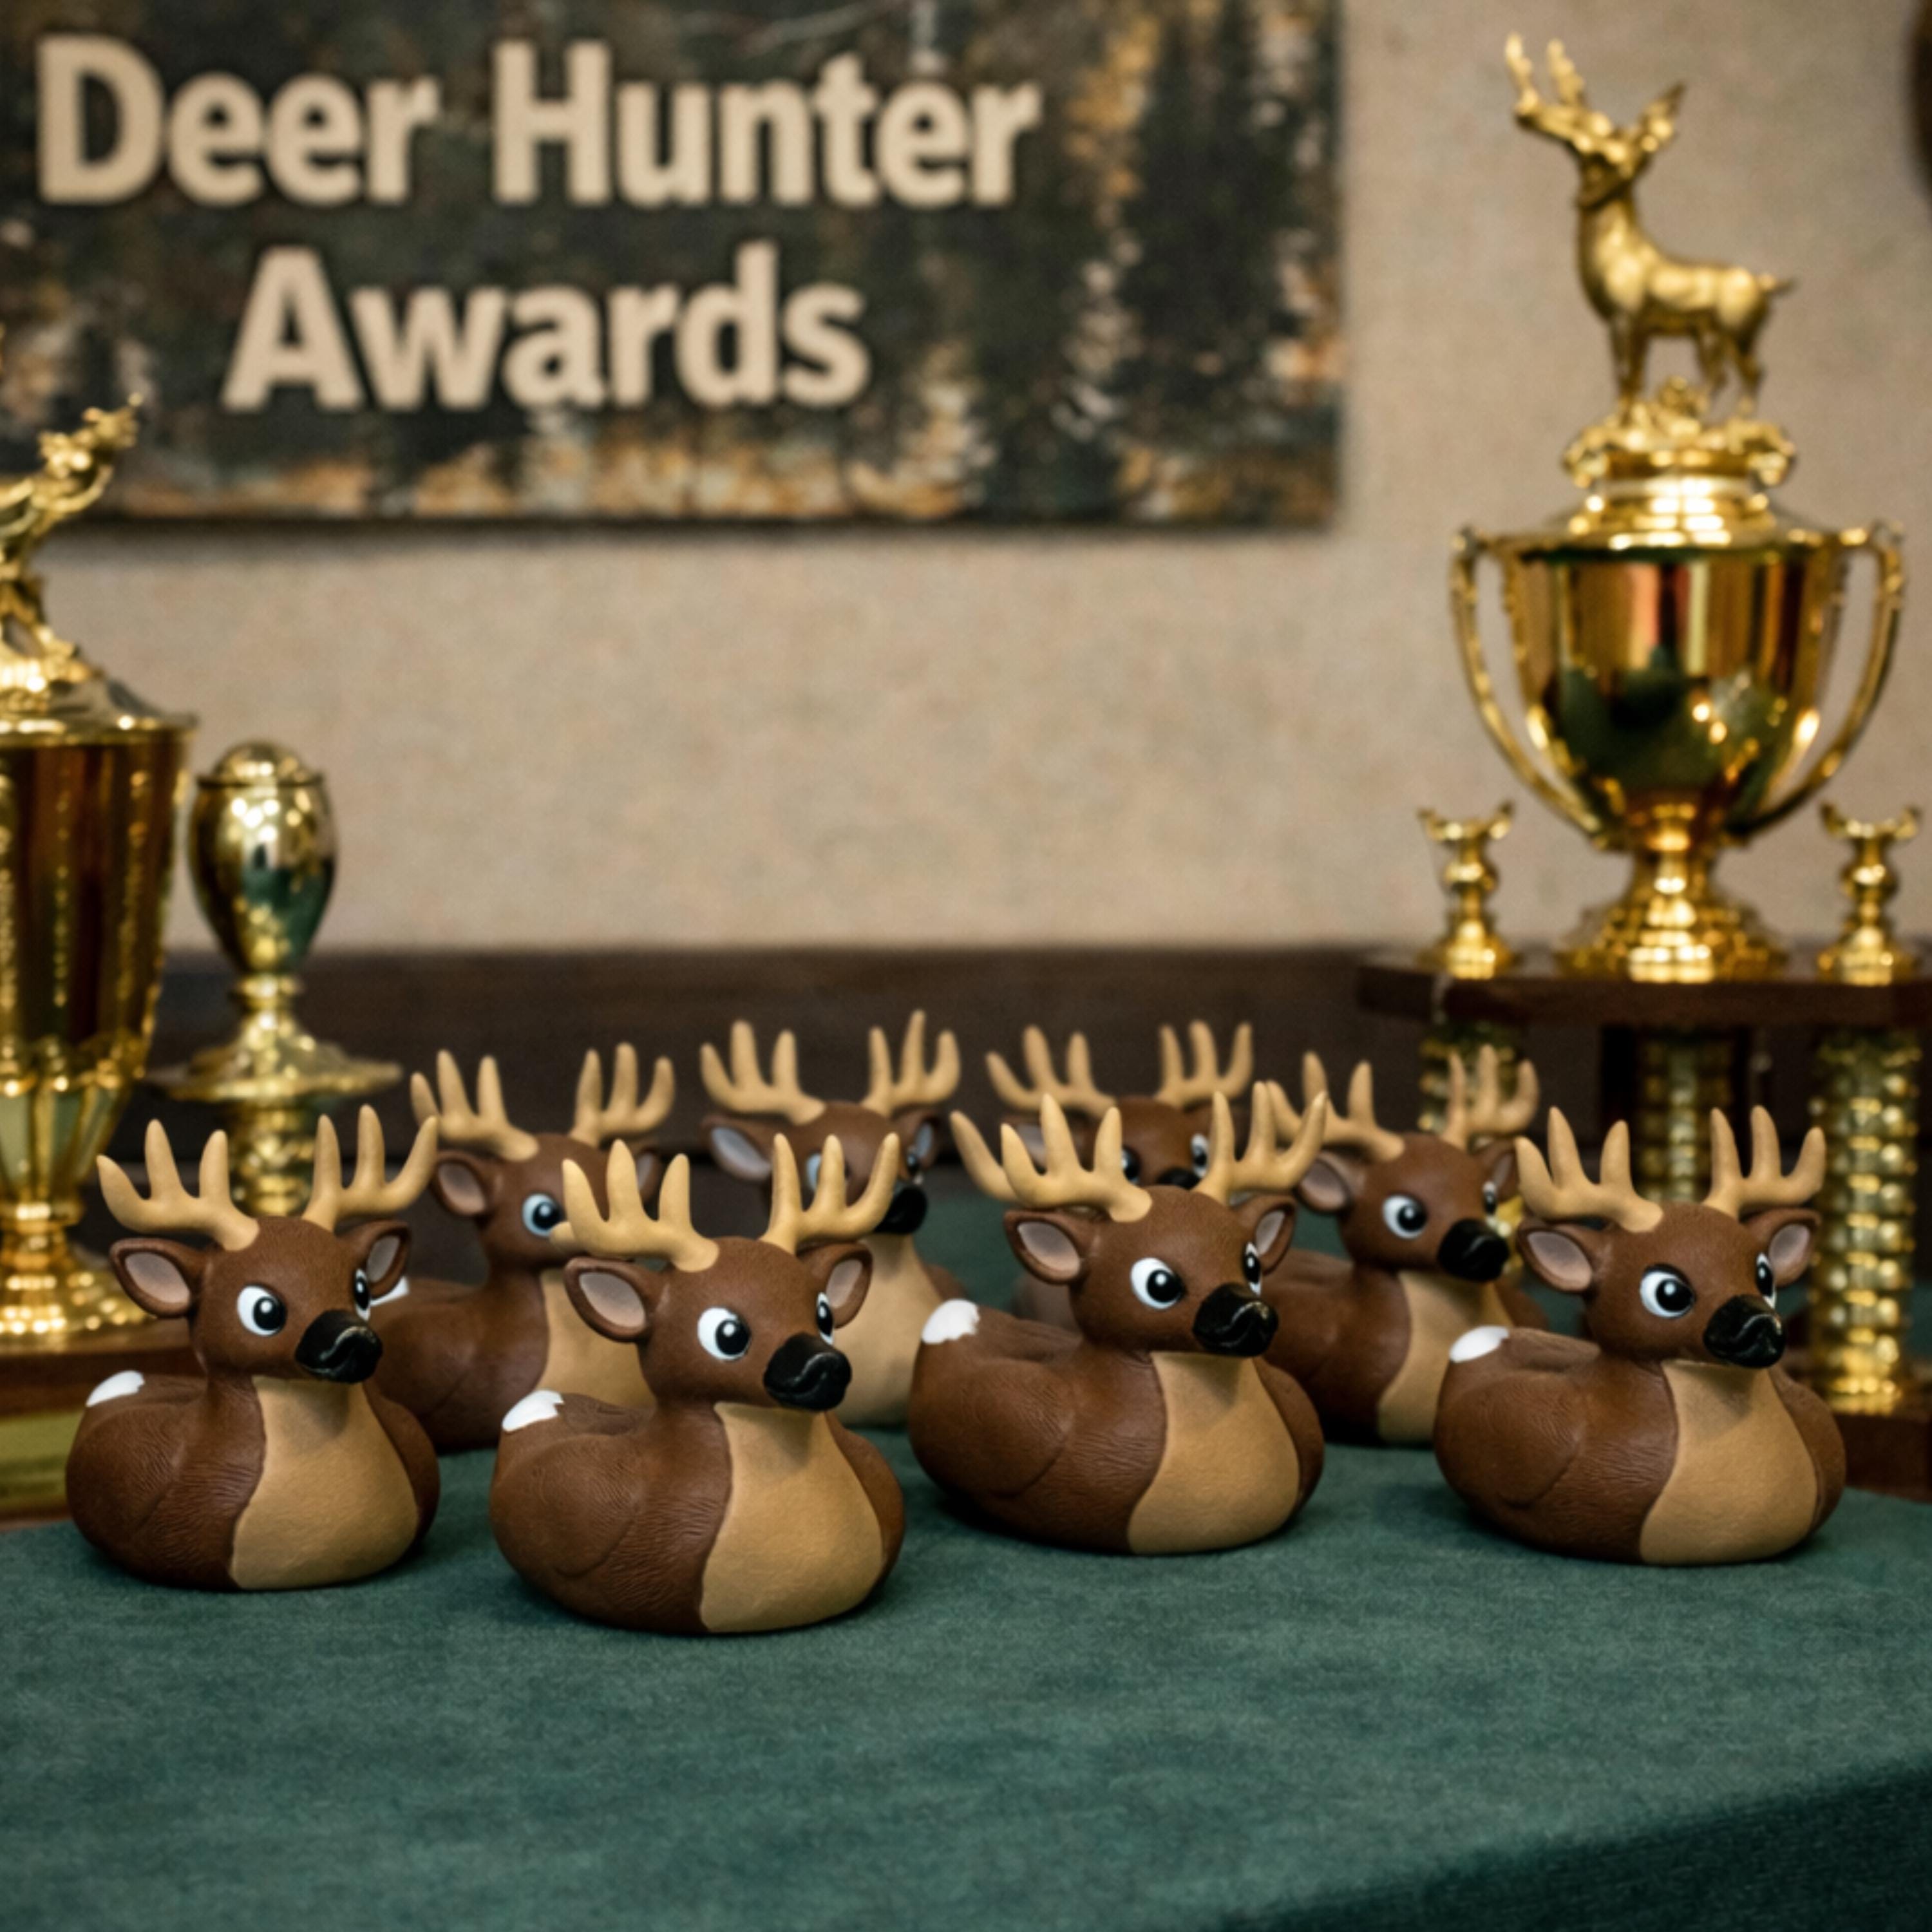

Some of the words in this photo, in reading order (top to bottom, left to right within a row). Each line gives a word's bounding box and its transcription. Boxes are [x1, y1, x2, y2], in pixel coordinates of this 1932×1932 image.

[39, 35, 438, 204] Deer
[493, 39, 1041, 205] Hunter
[223, 241, 869, 410] Awards
